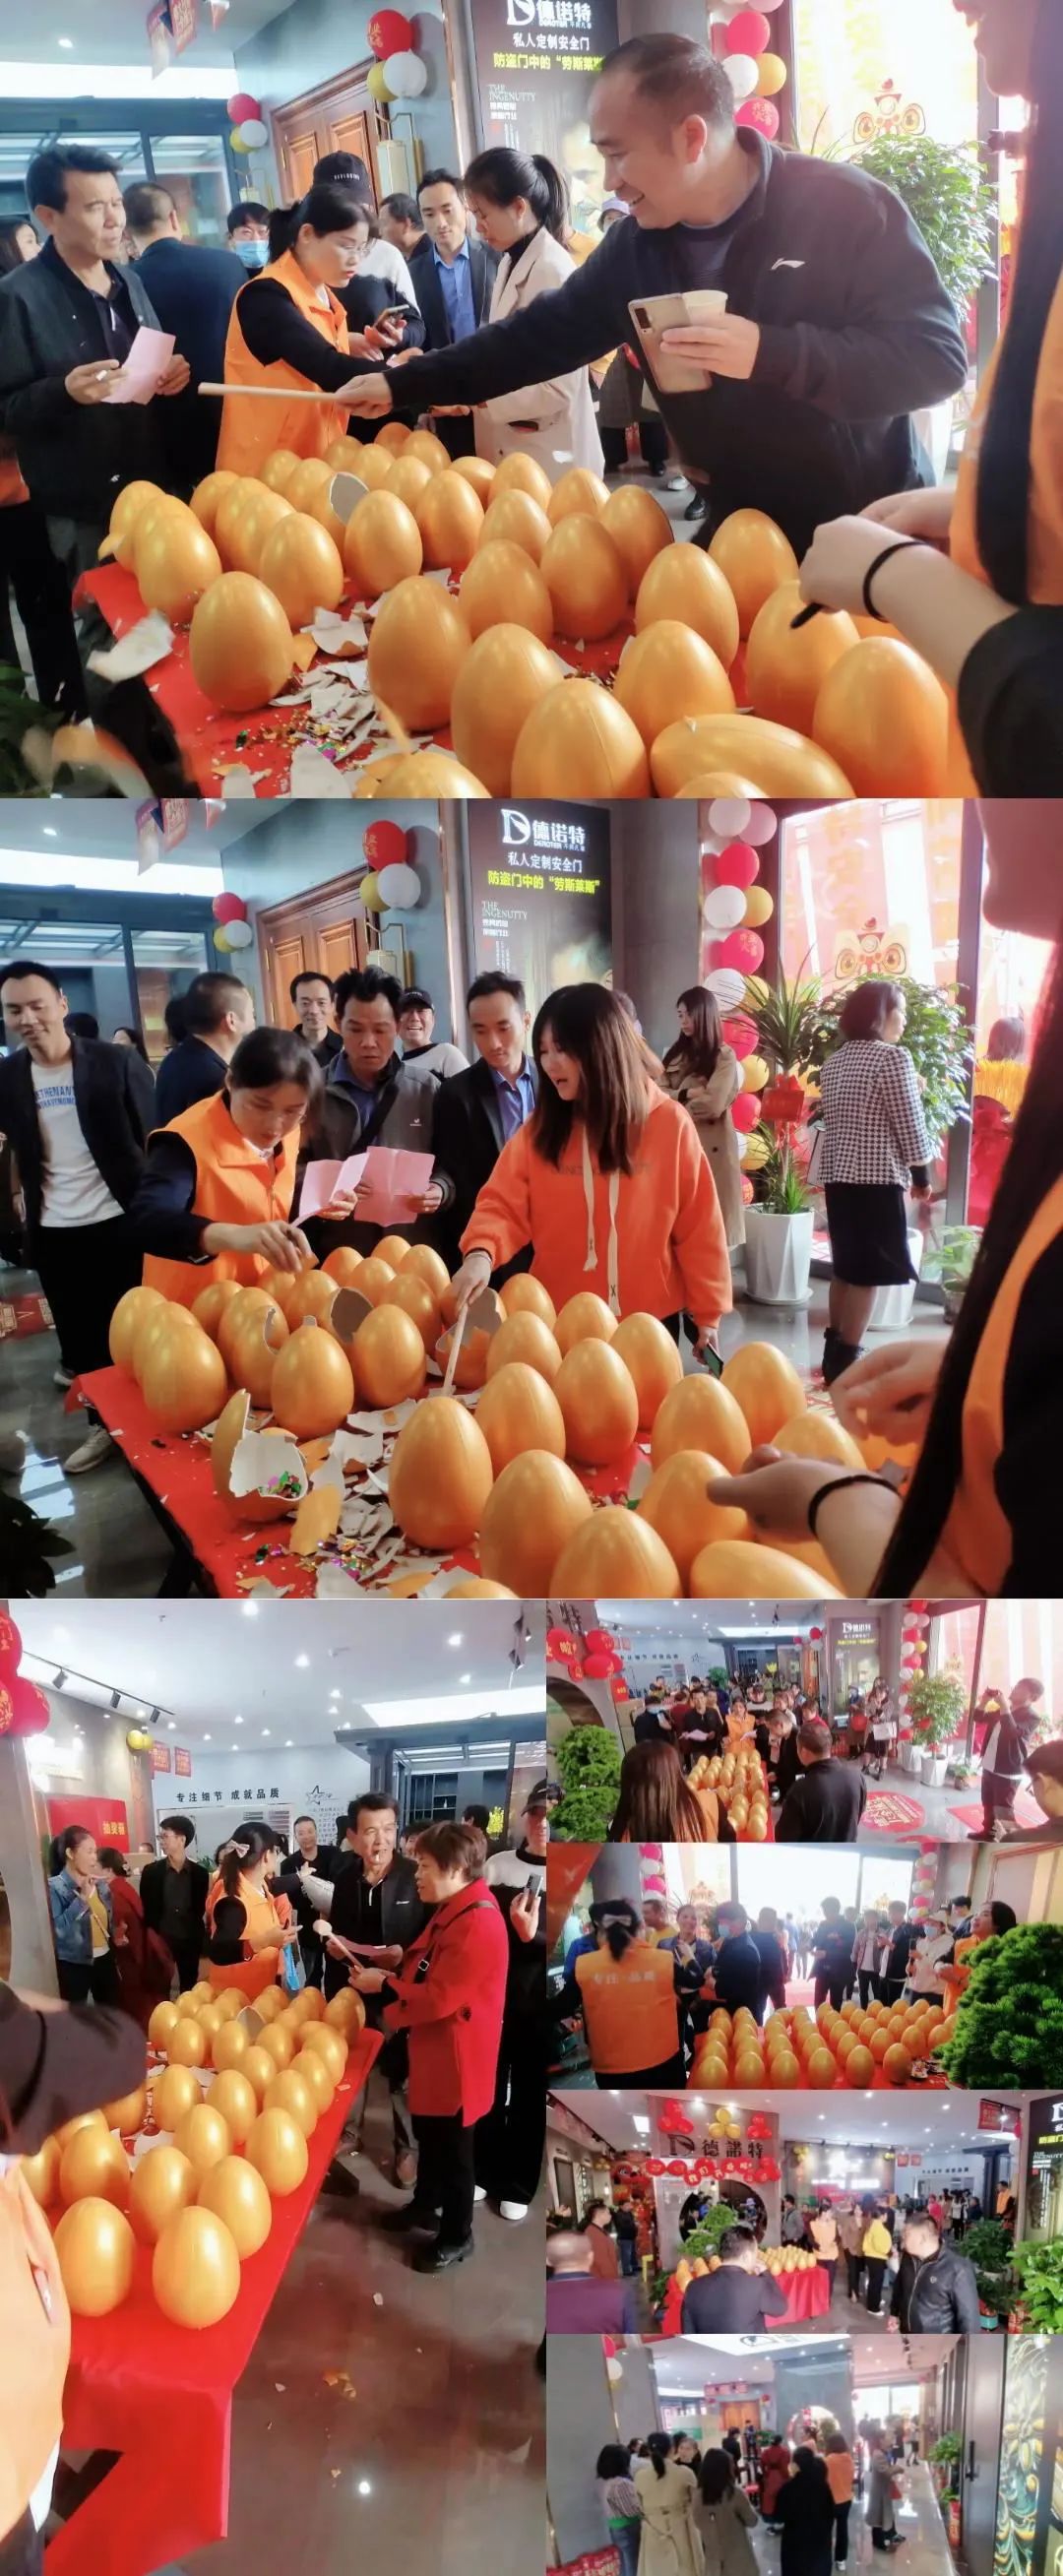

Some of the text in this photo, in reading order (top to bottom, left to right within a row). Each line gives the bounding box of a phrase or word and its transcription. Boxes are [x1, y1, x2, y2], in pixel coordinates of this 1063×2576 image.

[513, 31, 590, 51] 私人定制安全门
[532, 820, 586, 845] 德诺特
[508, 851, 583, 873] 私人定制安全门
[176, 1788, 280, 1802] 专注细节 成就品质
